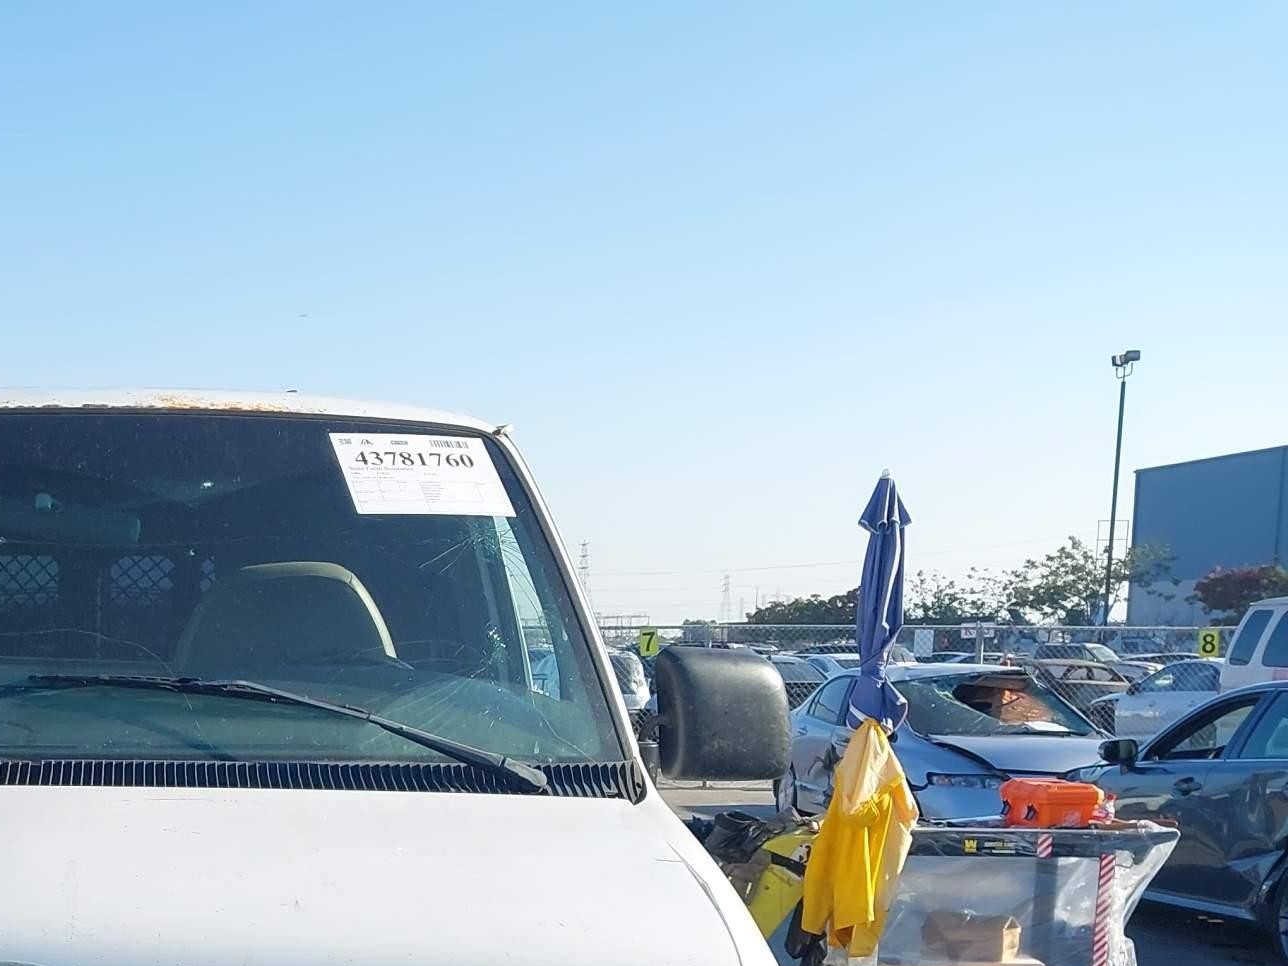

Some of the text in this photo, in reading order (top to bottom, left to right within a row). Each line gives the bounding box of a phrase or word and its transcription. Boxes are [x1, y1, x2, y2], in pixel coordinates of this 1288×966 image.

[355, 450, 475, 468] 43781760
[642, 632, 655, 651] 7
[1202, 633, 1216, 653] 8
